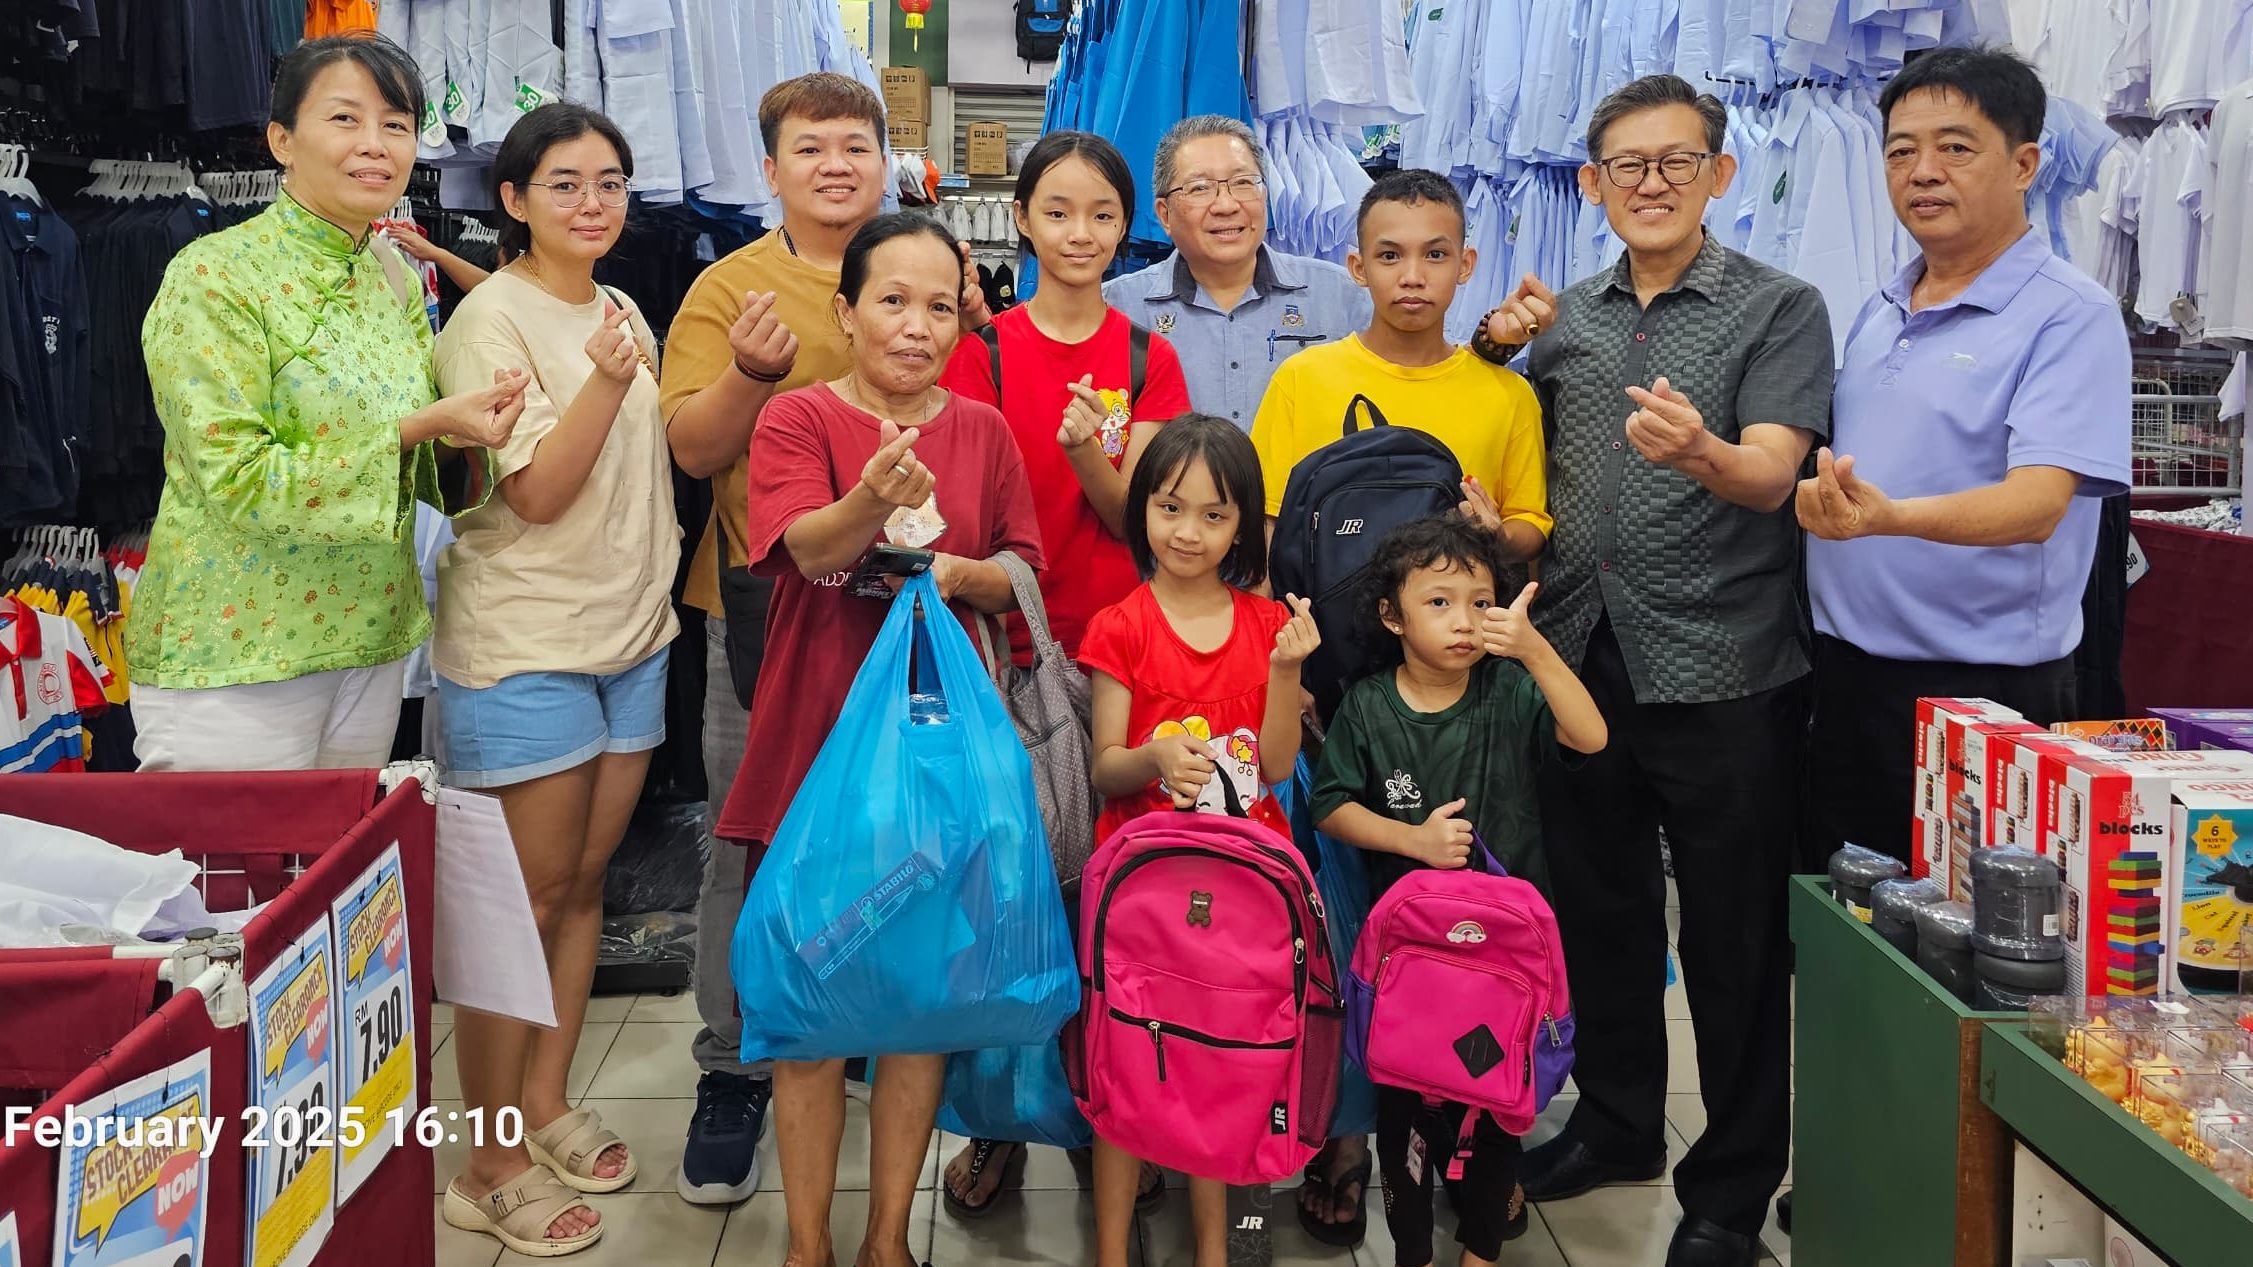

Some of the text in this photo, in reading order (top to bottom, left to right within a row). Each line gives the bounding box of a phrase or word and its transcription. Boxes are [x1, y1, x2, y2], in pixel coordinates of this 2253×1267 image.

[446, 91, 460, 111] 30
[523, 92, 540, 112] 30
[1336, 519, 1363, 535] JR
[1949, 759, 1982, 785] blocks
[2118, 804, 2145, 818] pcs
[2121, 792, 2140, 804] 54
[2099, 822, 2163, 835] blocks
[2211, 826, 2219, 836] 6
[873, 863, 914, 901] STABILO
[364, 882, 397, 953] CLEARANCE
[2191, 902, 2211, 911] Lion
[350, 907, 372, 956] STOCK
[384, 918, 403, 956] NOW
[284, 963, 324, 1046] CLEARANCE
[355, 1000, 369, 1026] RM
[267, 990, 292, 1048] STOCK
[306, 1004, 329, 1050] NOW
[359, 985, 403, 1085] 7.90
[1275, 1107, 1286, 1131] JR
[158, 1161, 200, 1216] NOW
[1236, 1216, 1264, 1230] JR
